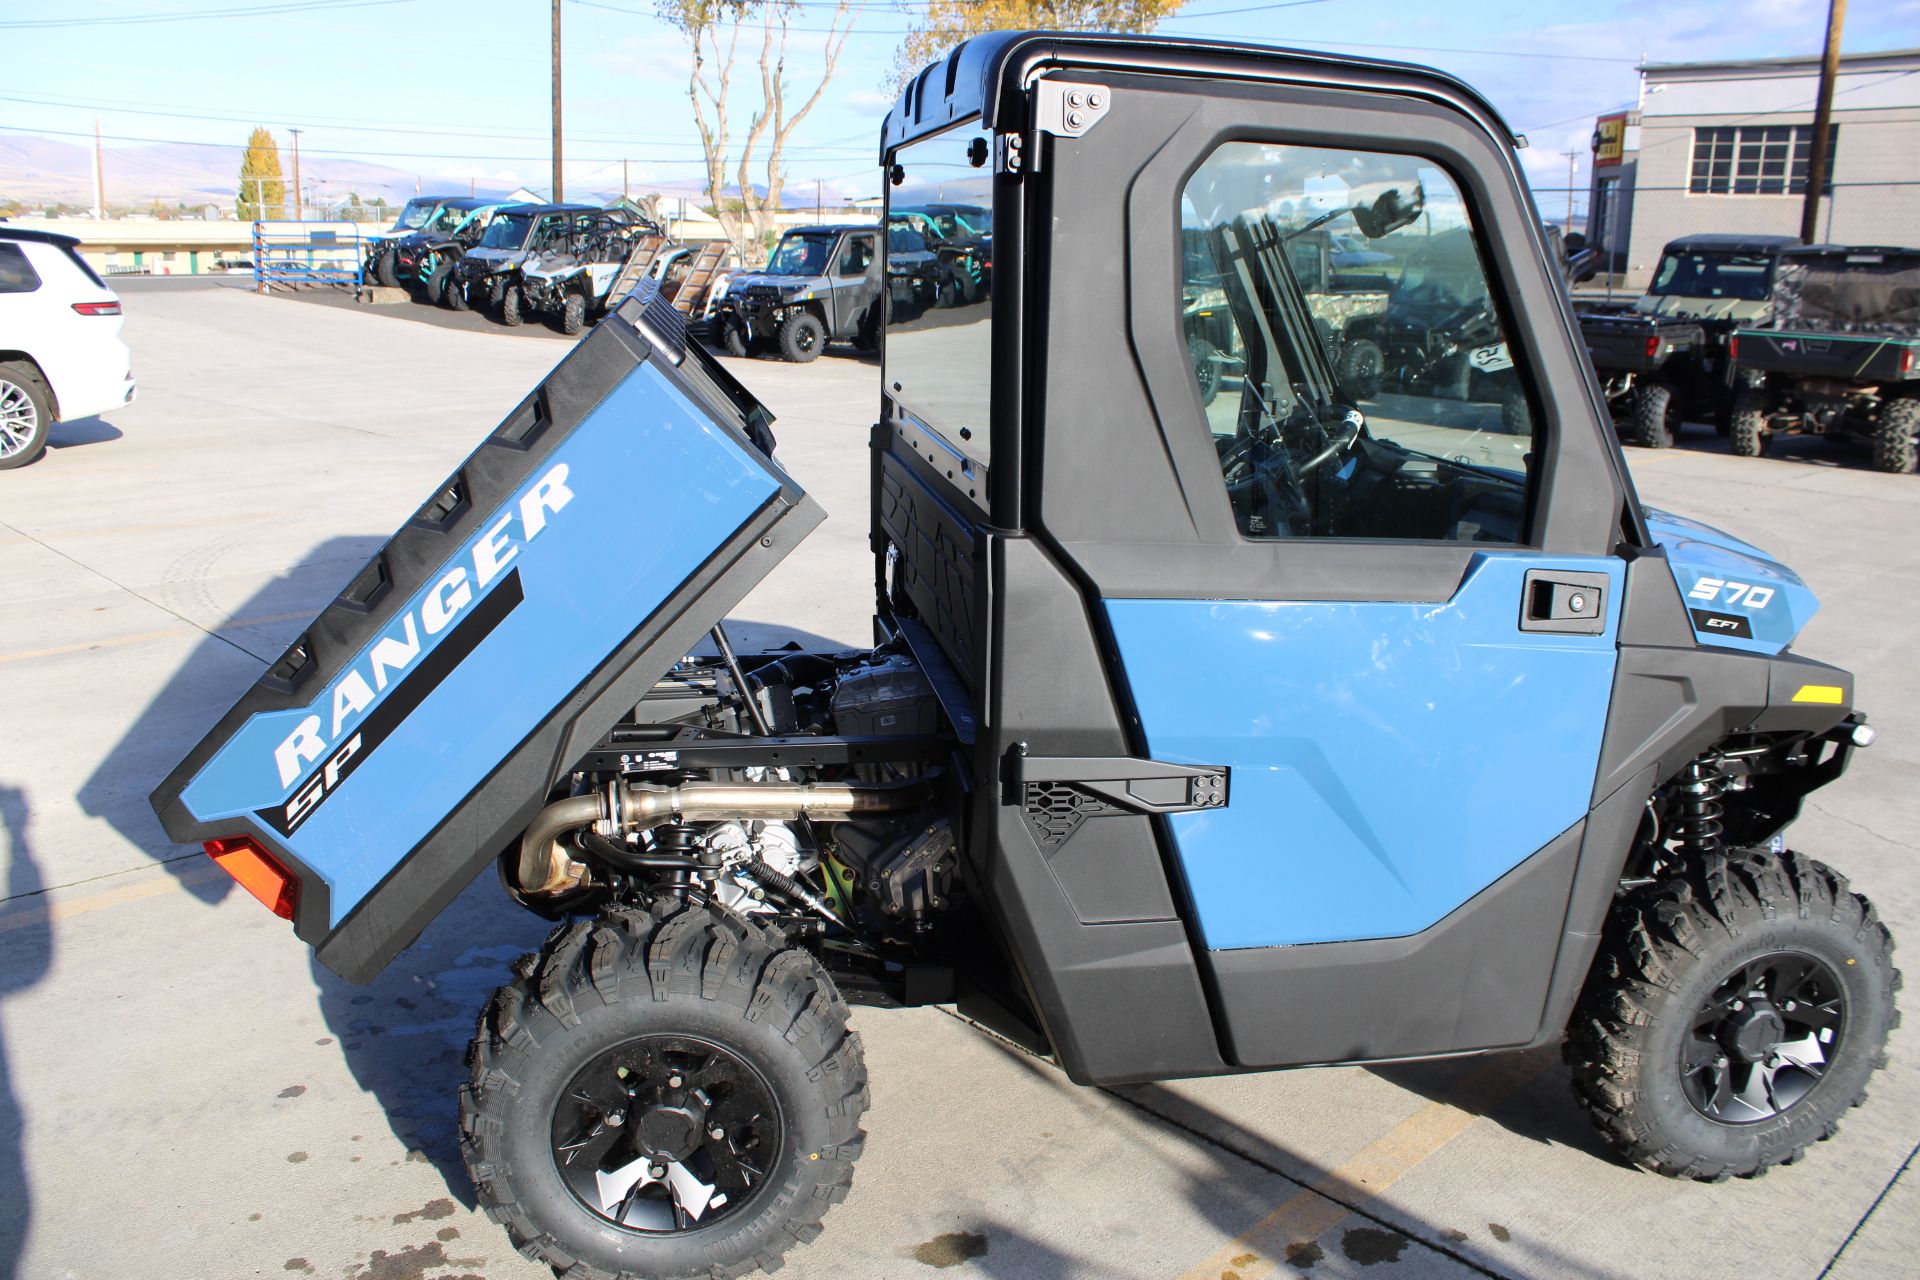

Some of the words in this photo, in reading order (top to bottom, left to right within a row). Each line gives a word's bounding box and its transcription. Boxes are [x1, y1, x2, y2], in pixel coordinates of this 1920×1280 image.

[273, 462, 575, 790] RANGER
[1705, 618, 1739, 630] EFI
[286, 732, 362, 831] SP
